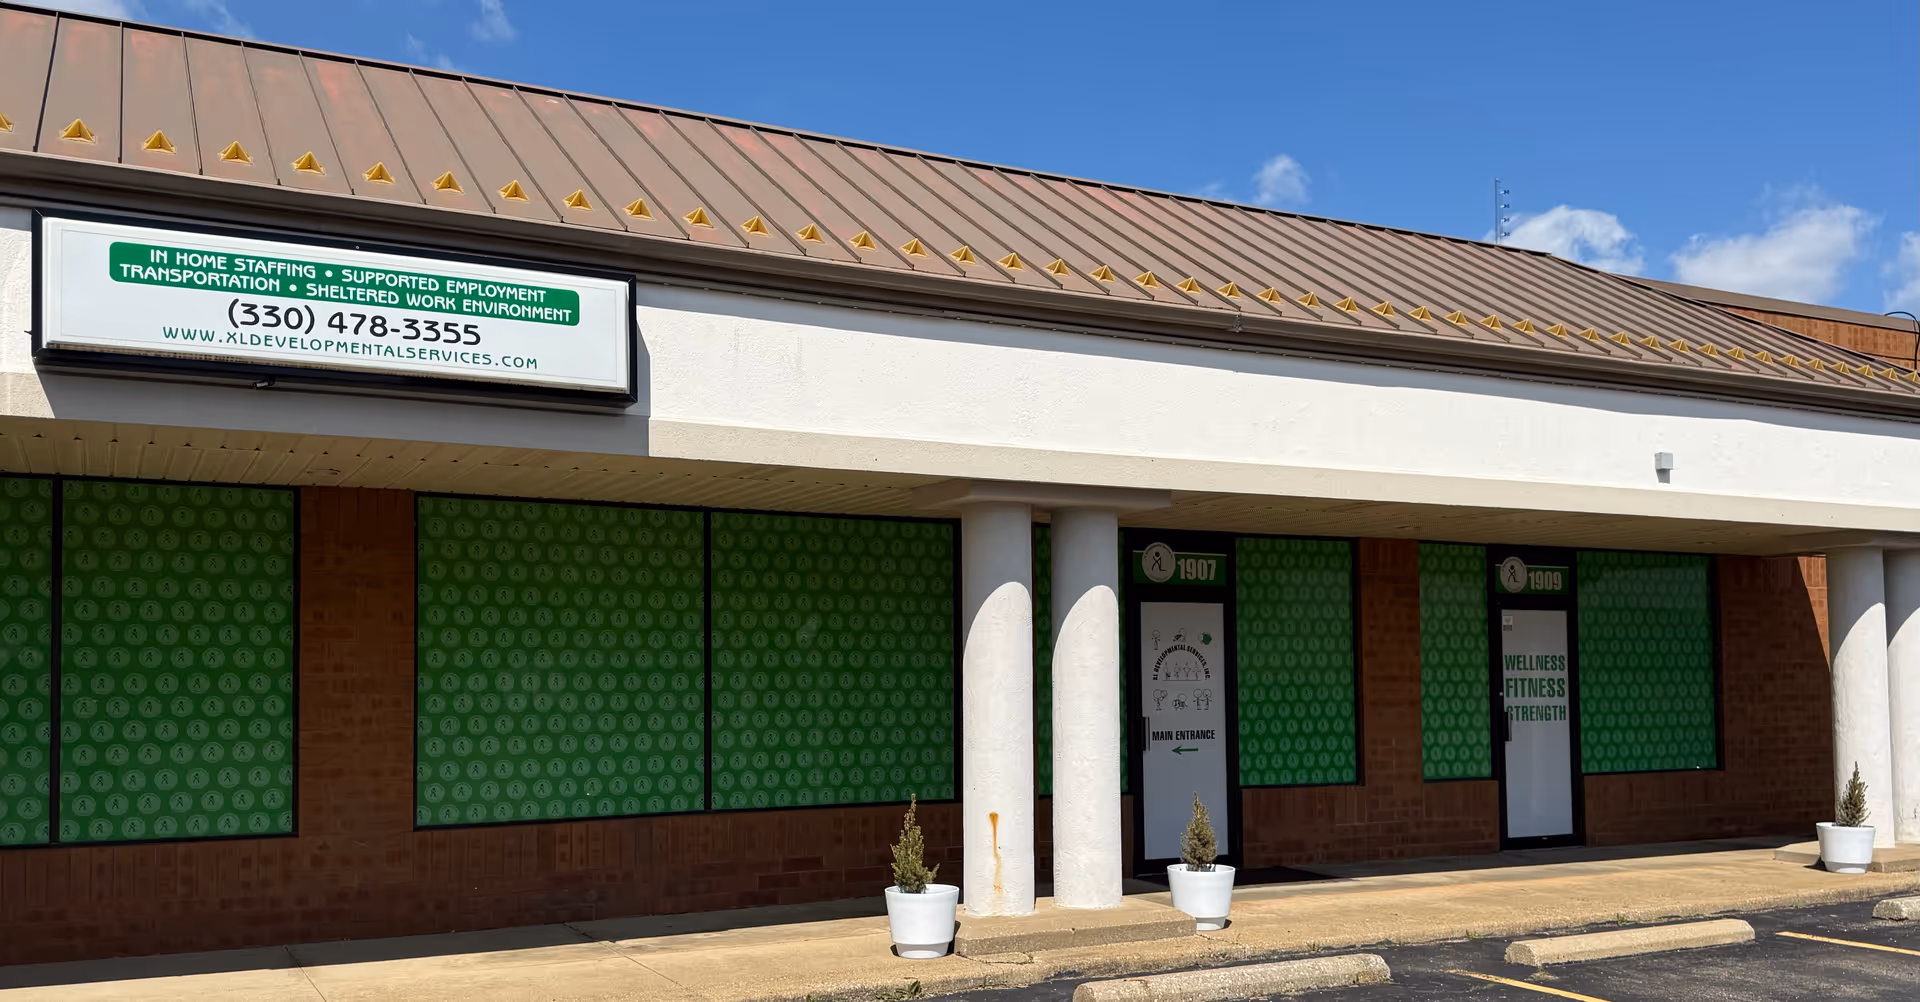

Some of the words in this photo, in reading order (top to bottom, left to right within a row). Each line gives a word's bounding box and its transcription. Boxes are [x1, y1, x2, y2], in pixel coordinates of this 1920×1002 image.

[150, 248, 168, 264] IN
[176, 251, 227, 270] HOME
[234, 257, 316, 279] STAFFING
[341, 268, 439, 292] SUPPORTED
[446, 279, 547, 303] EMPLOYMENT
[119, 263, 281, 292] TRANSPORTATION
[306, 283, 400, 305] SHELTERED
[406, 292, 456, 311] WORK
[462, 298, 572, 323] ENVIRONMENT
[228, 298, 316, 335] (330)
[327, 311, 482, 346] 478-3355
[162, 325, 538, 370] WWW.XLDEVELOPMENTALSERVICES.COM
[1177, 558, 1217, 581] 1907
[1528, 570, 1562, 591] 1909
[1504, 654, 1566, 672] WELLNESS
[1505, 677, 1566, 699] FITNESS
[1152, 730, 1173, 741] MAIN
[1175, 729, 1216, 740] ENTRANCE
